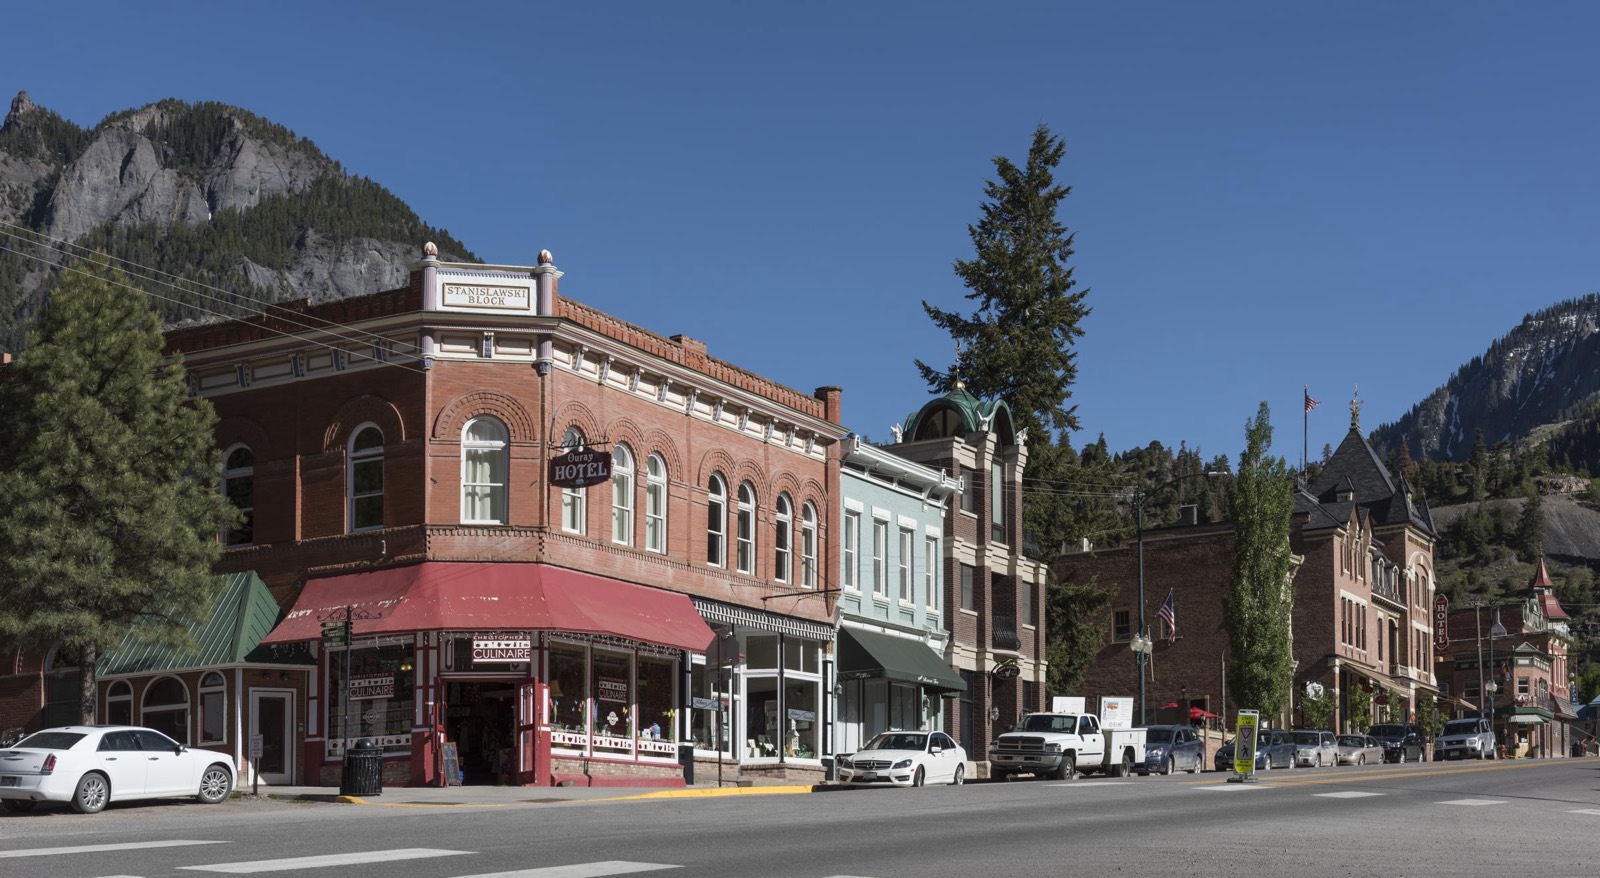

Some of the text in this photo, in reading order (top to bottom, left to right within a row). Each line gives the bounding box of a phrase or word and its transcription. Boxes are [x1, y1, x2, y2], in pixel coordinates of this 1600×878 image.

[447, 286, 526, 298] STANISLAWSKI
[468, 295, 507, 306] BLOCK
[567, 453, 594, 463] Ouray
[555, 462, 608, 480] HOTEL
[1437, 604, 1446, 644] HOTEL
[473, 649, 531, 659] CULINAIRE
[349, 684, 395, 698] CULINAIRE
[598, 688, 628, 700] CULINAIRE
